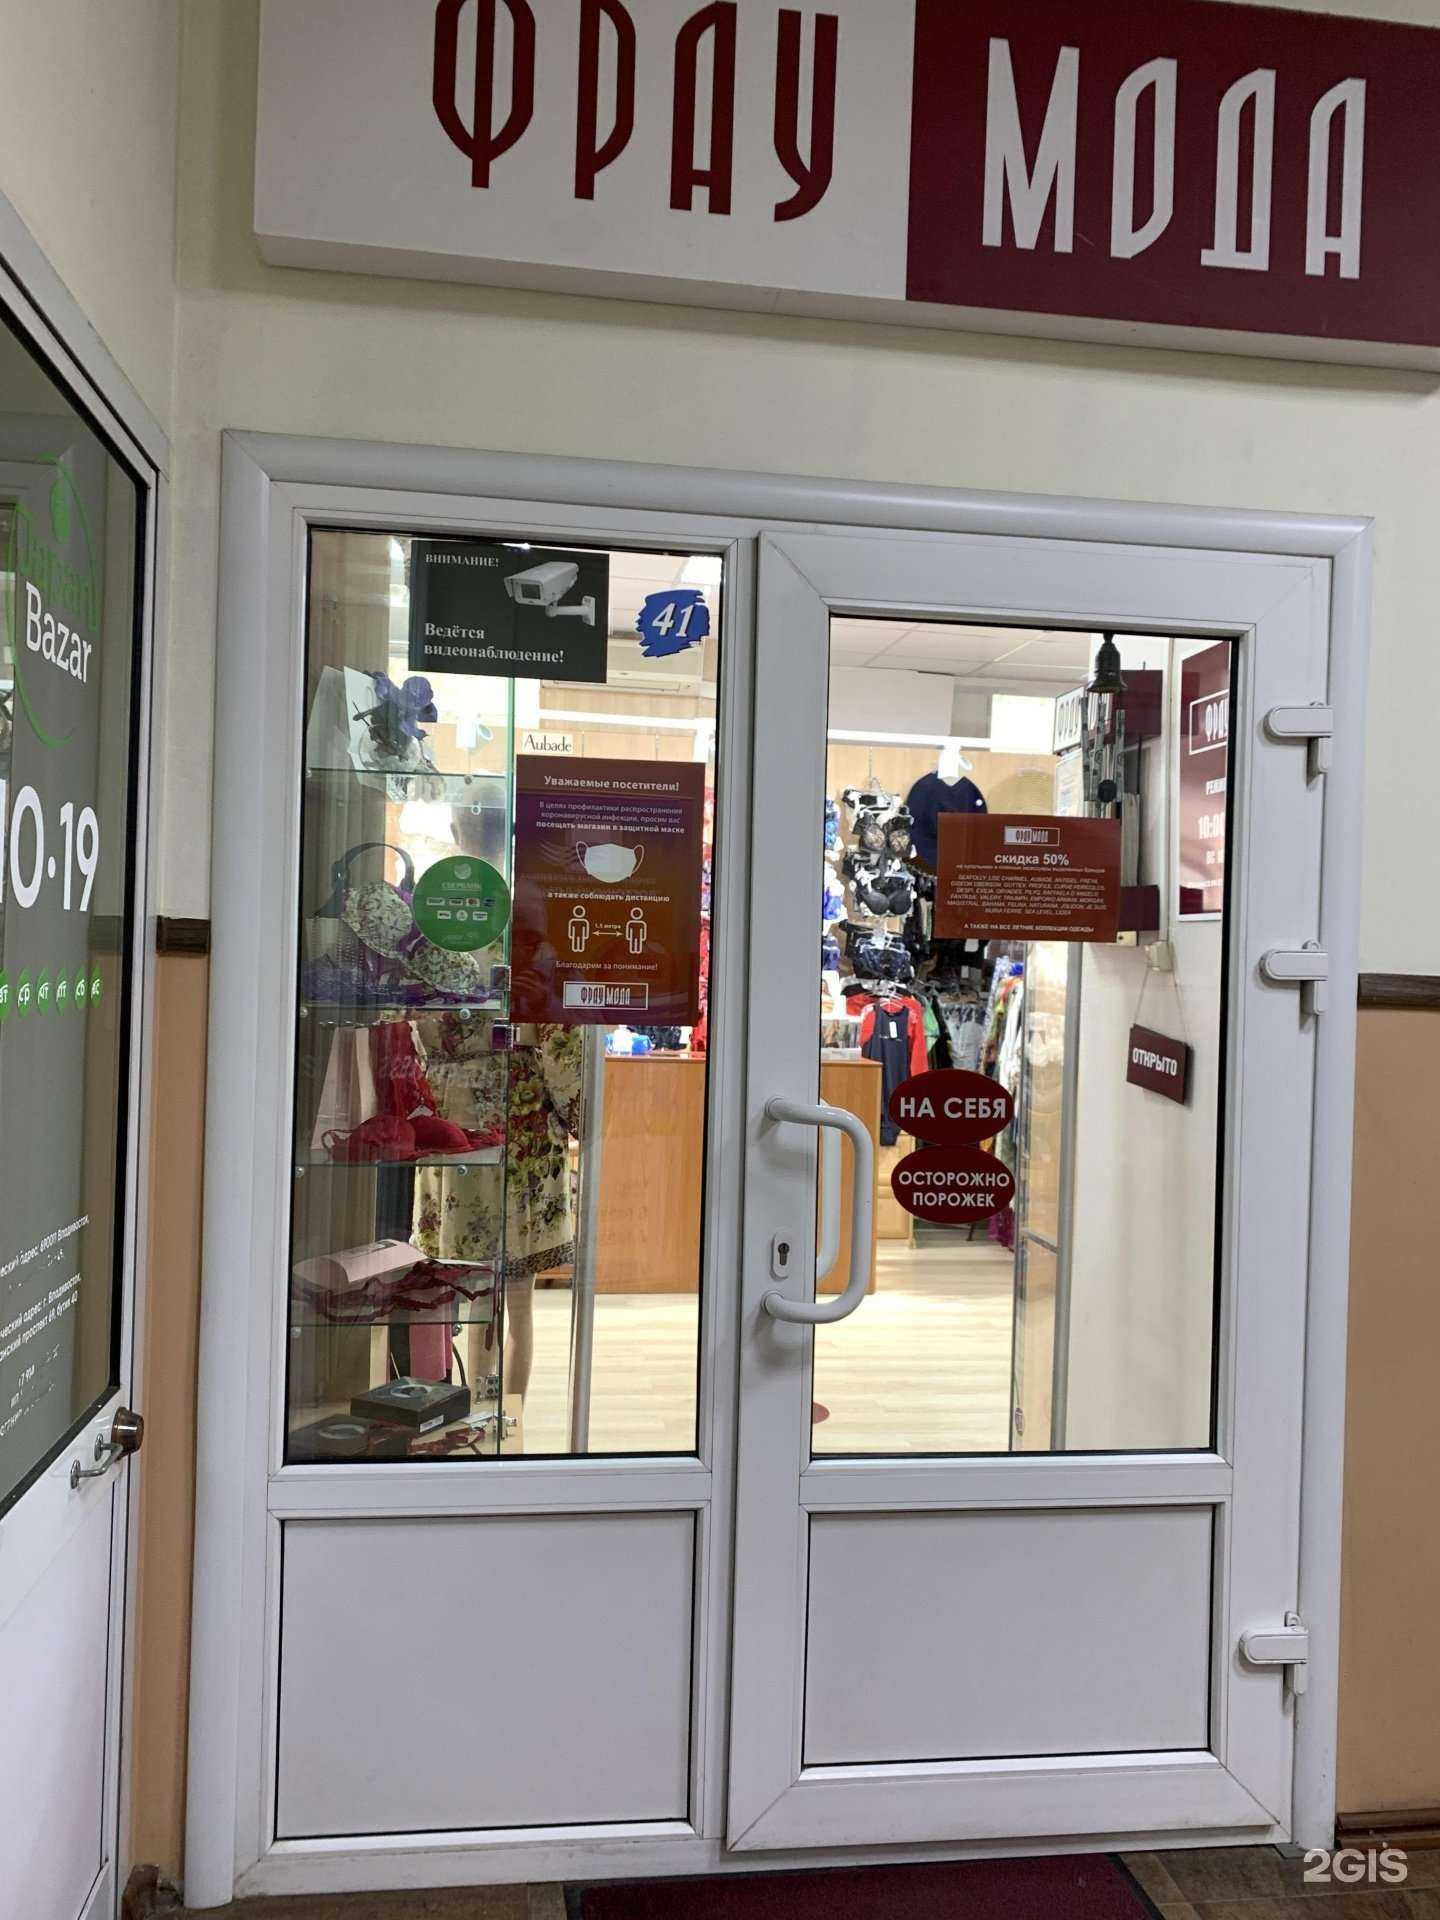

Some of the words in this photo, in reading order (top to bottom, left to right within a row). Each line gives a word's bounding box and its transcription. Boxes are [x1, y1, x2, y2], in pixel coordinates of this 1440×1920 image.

[432, 0, 838, 222] ФРАУ
[983, 37, 1366, 279] МОДА
[425, 553, 499, 567] ВНИМАНИЕ!
[652, 603, 695, 637] 41
[26, 580, 92, 682] Bazar
[424, 623, 485, 639] Ведётся
[424, 645, 565, 663] видеонаблюдение!
[524, 734, 572, 752] Aubade
[544, 776, 610, 788] Уважаемые
[612, 780, 680, 791] посетители!
[994, 854, 1039, 865] скидка
[1043, 854, 1069, 866] 50%
[556, 960, 602, 971] Благодарим
[603, 962, 612, 970] за
[614, 962, 658, 971] понимание!
[1132, 1047, 1177, 1076] ОТКРЫТО
[900, 1097, 936, 1118] НА
[943, 1097, 1006, 1119] СЕБЯ
[899, 1171, 1010, 1187] ОСТОРОЖНО
[912, 1192, 995, 1207] ПОРОЖЕК
